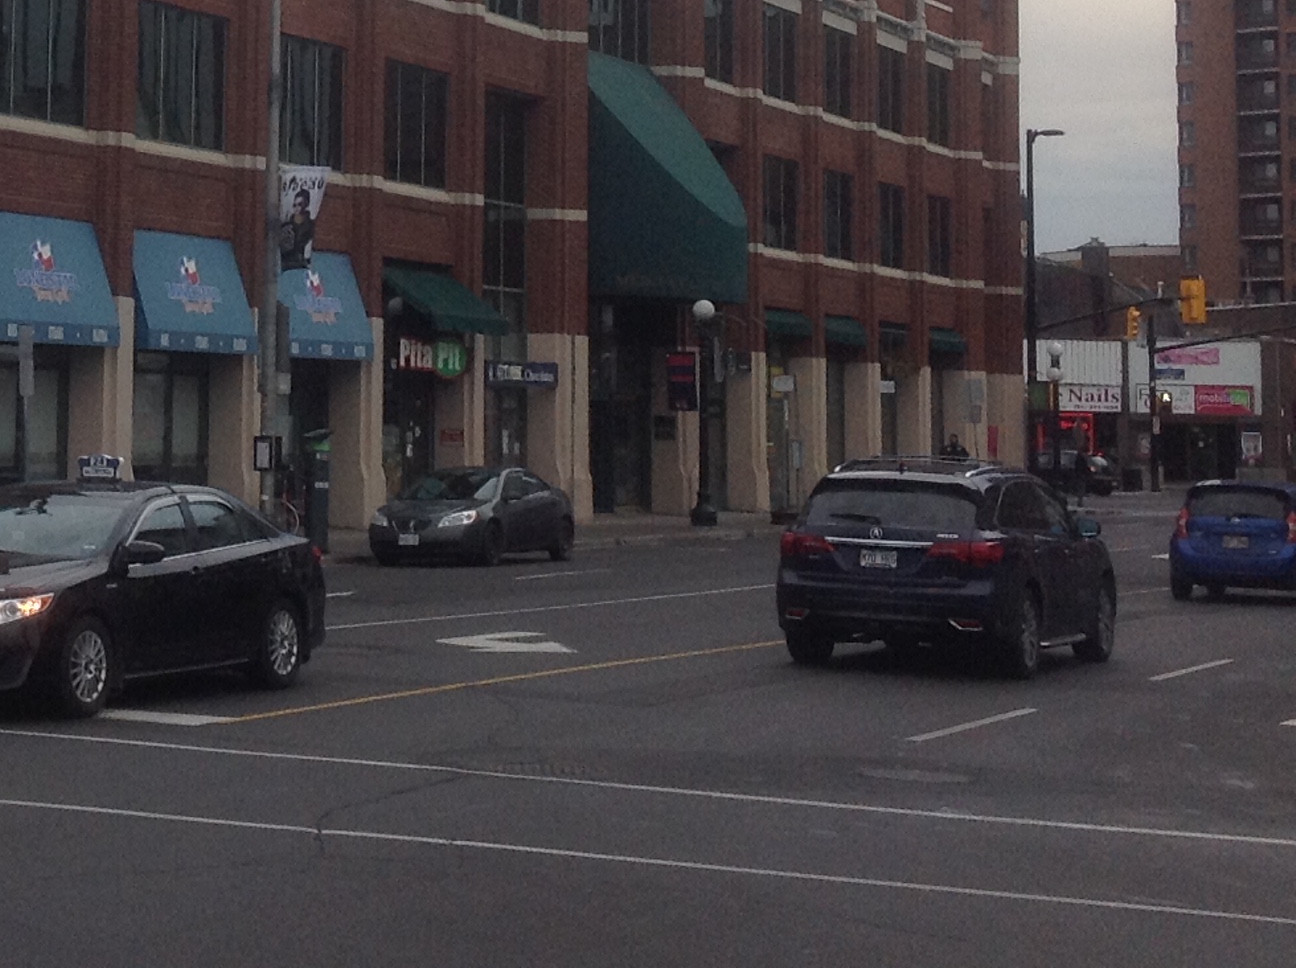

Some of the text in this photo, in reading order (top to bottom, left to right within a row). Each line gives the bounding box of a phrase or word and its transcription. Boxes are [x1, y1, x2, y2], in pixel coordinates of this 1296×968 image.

[399, 338, 461, 370] Pita Pit
[1069, 388, 1119, 403] Nails
